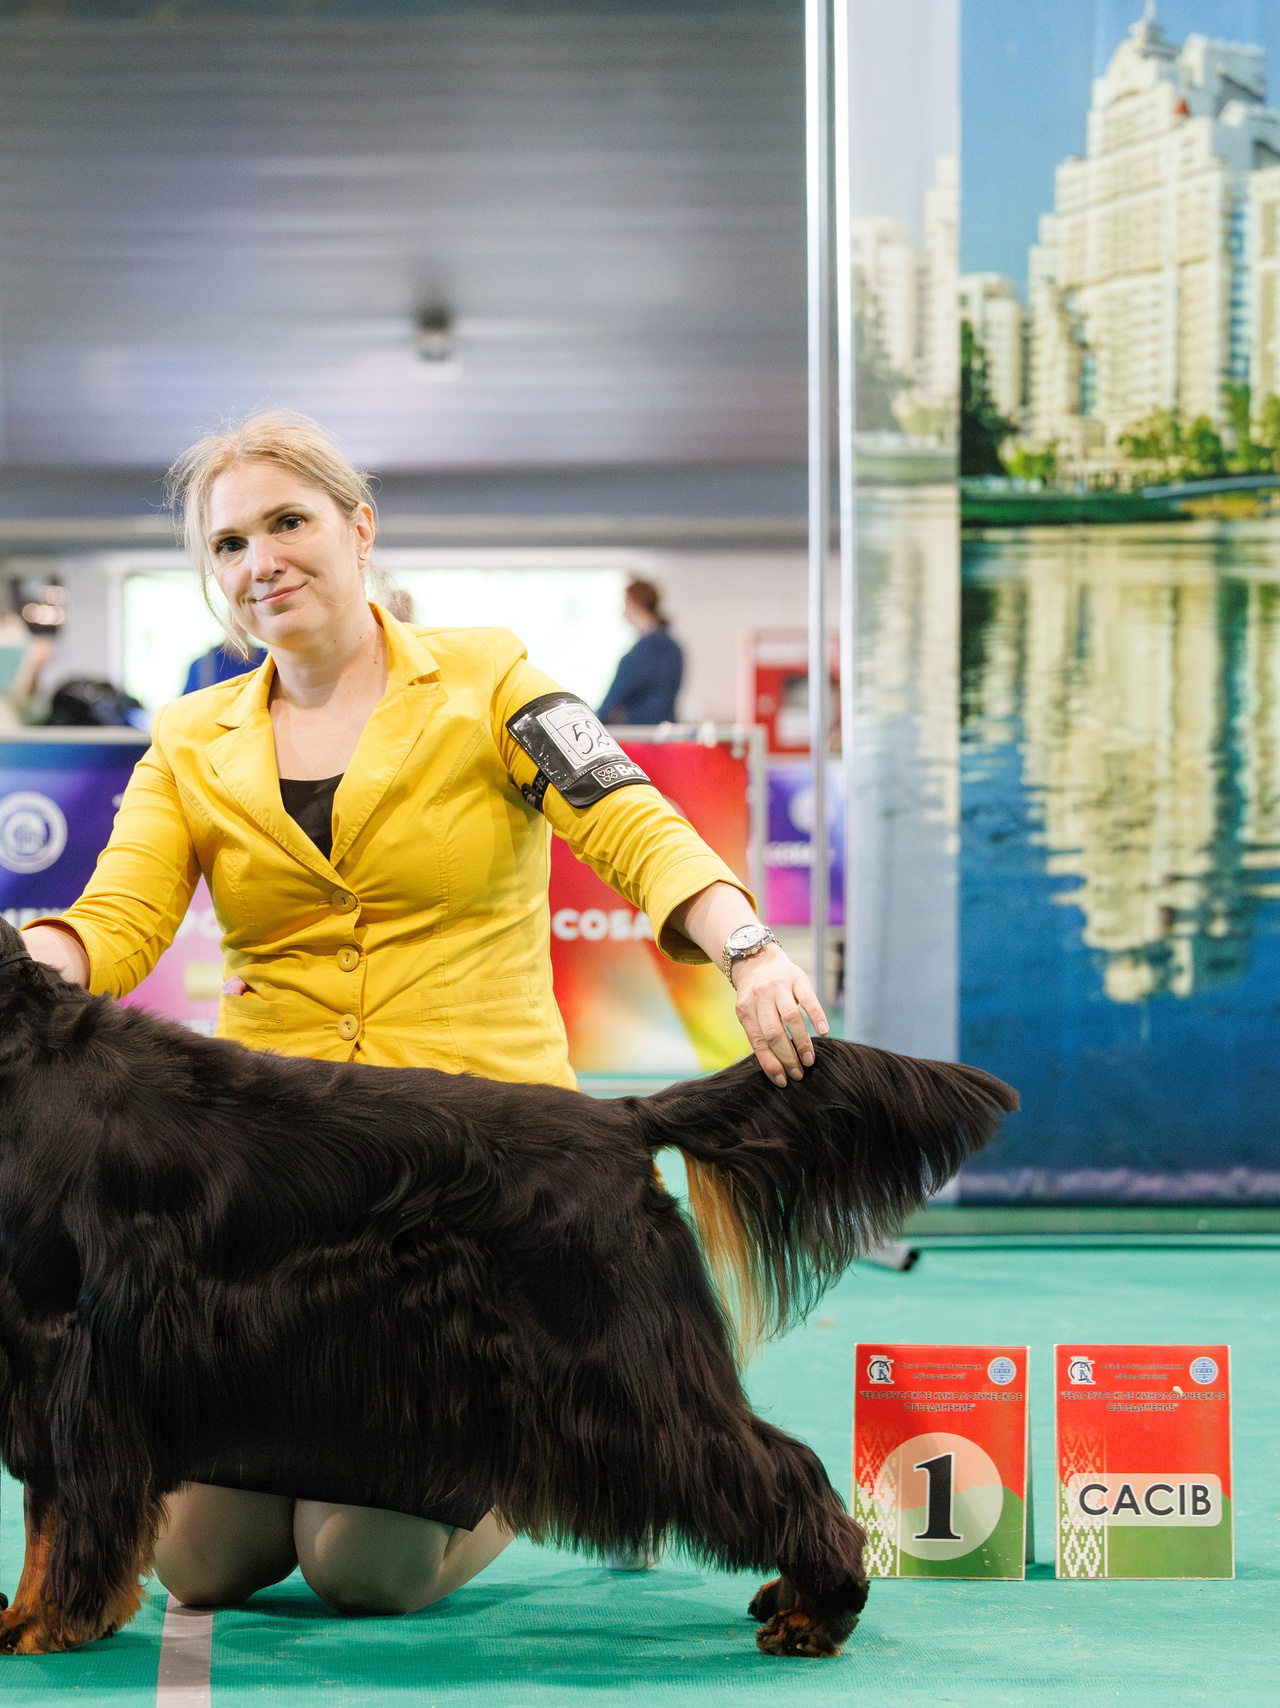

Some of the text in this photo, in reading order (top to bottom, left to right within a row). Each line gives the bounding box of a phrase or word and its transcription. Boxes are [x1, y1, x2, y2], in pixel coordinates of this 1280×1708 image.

[552, 908, 656, 941] СОБА
[934, 1391, 1023, 1401] КИНОЛОГИЧЕСКОЕ
[1136, 1391, 1225, 1401] КИНОЛОГИЧЕСКОЕ
[913, 1451, 963, 1542] 1
[1079, 1483, 1212, 1517] CACIB
